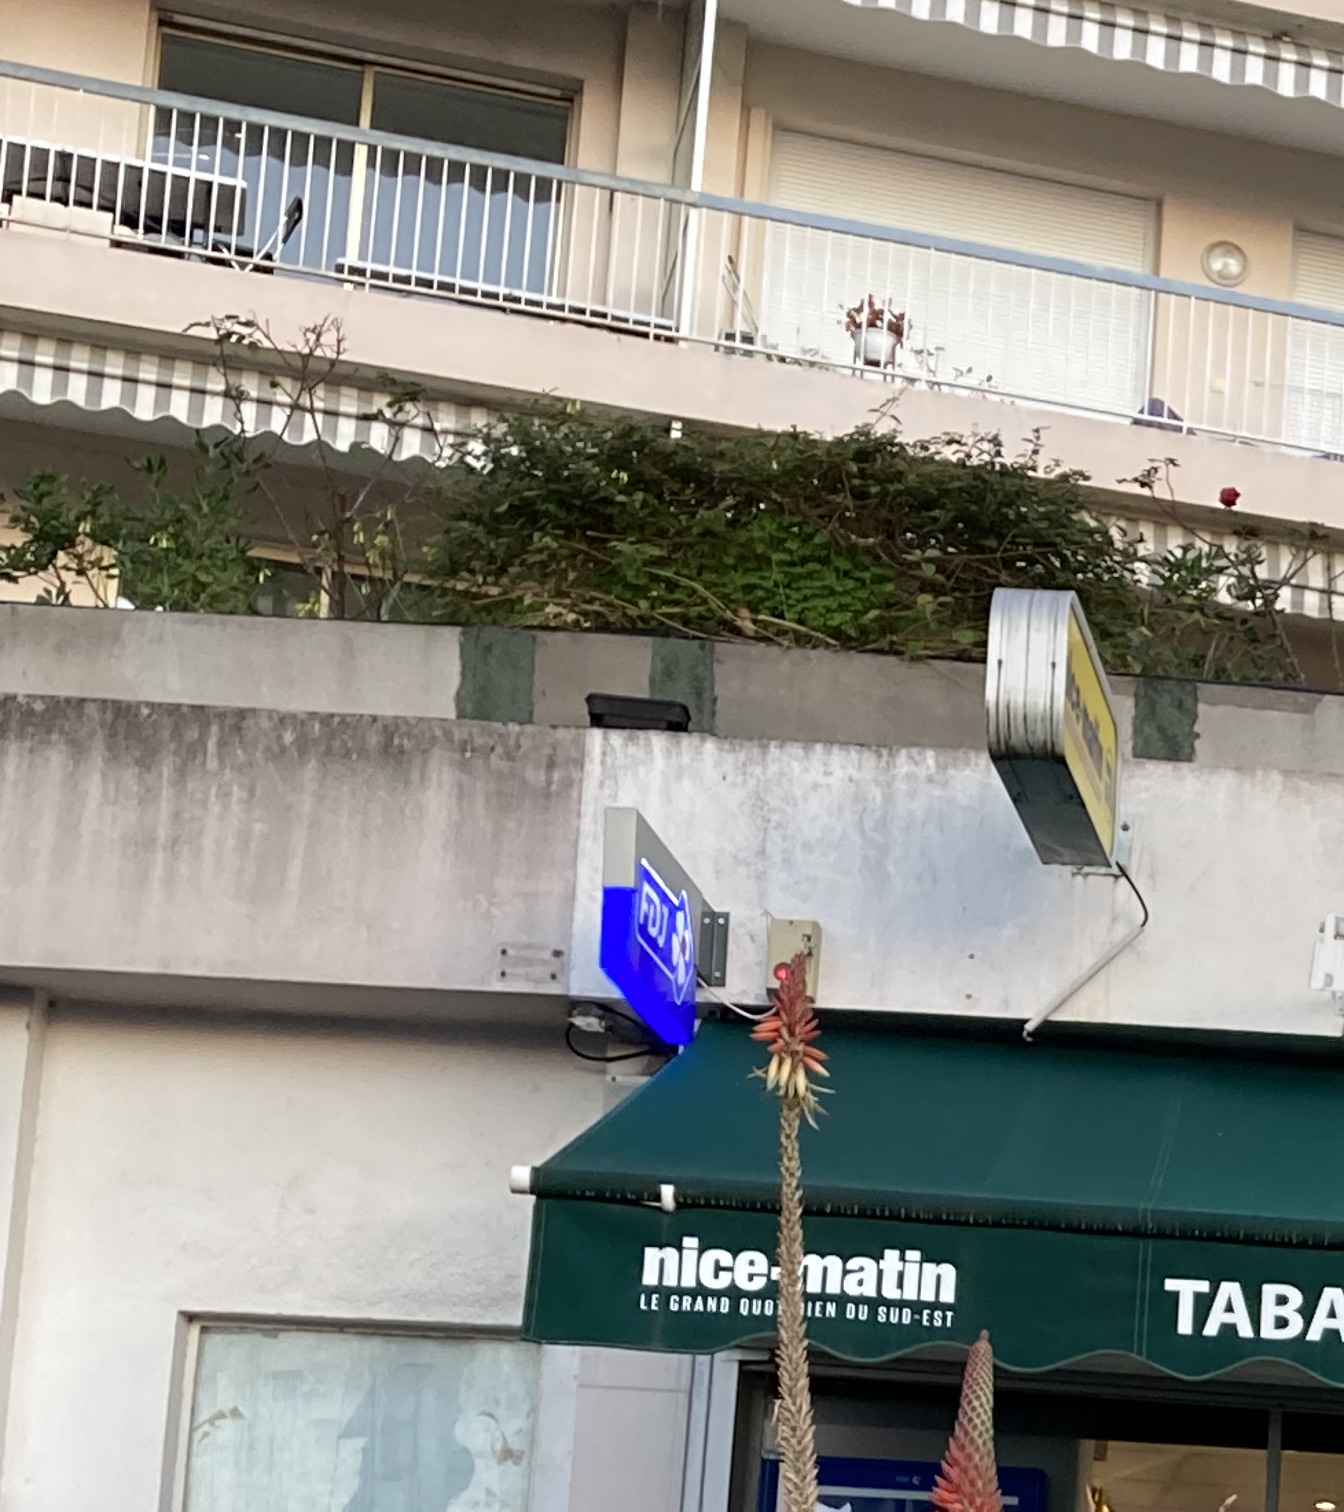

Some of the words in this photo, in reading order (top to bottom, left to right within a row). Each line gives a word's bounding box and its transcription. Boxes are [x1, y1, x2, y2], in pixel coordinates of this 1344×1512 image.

[639, 880, 669, 949] FDJ
[641, 1236, 957, 1303] nice-matin
[639, 1293, 660, 1311] LE
[669, 1294, 730, 1315] GRAND
[738, 1297, 837, 1319] QUOIEN
[846, 1301, 869, 1321] DU
[877, 1302, 955, 1328] SUD-EST
